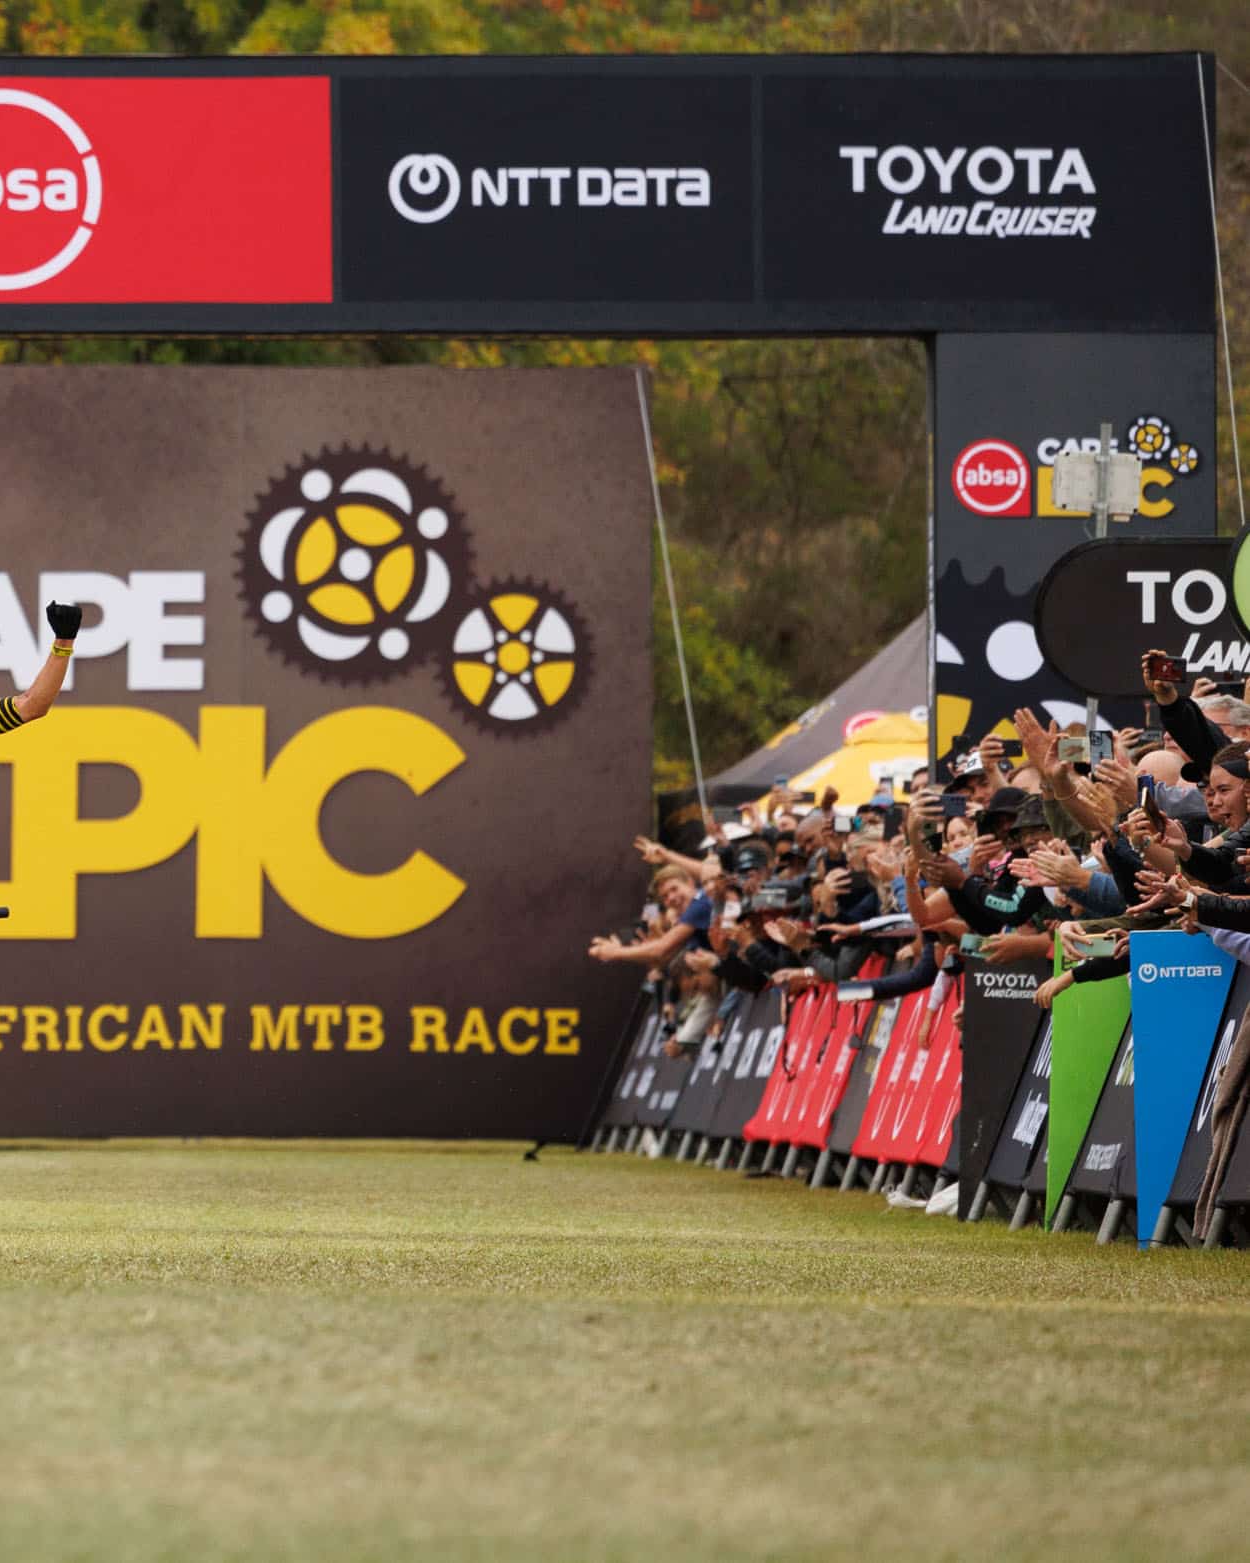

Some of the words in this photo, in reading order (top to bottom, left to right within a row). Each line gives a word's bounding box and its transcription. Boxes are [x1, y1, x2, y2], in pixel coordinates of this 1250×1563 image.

[839, 145, 1096, 195] TOYOTA
[965, 463, 1018, 486] absa
[973, 972, 1038, 988] TOYOTA
[249, 1004, 385, 1051] MTB
[409, 1006, 579, 1054] RACE
